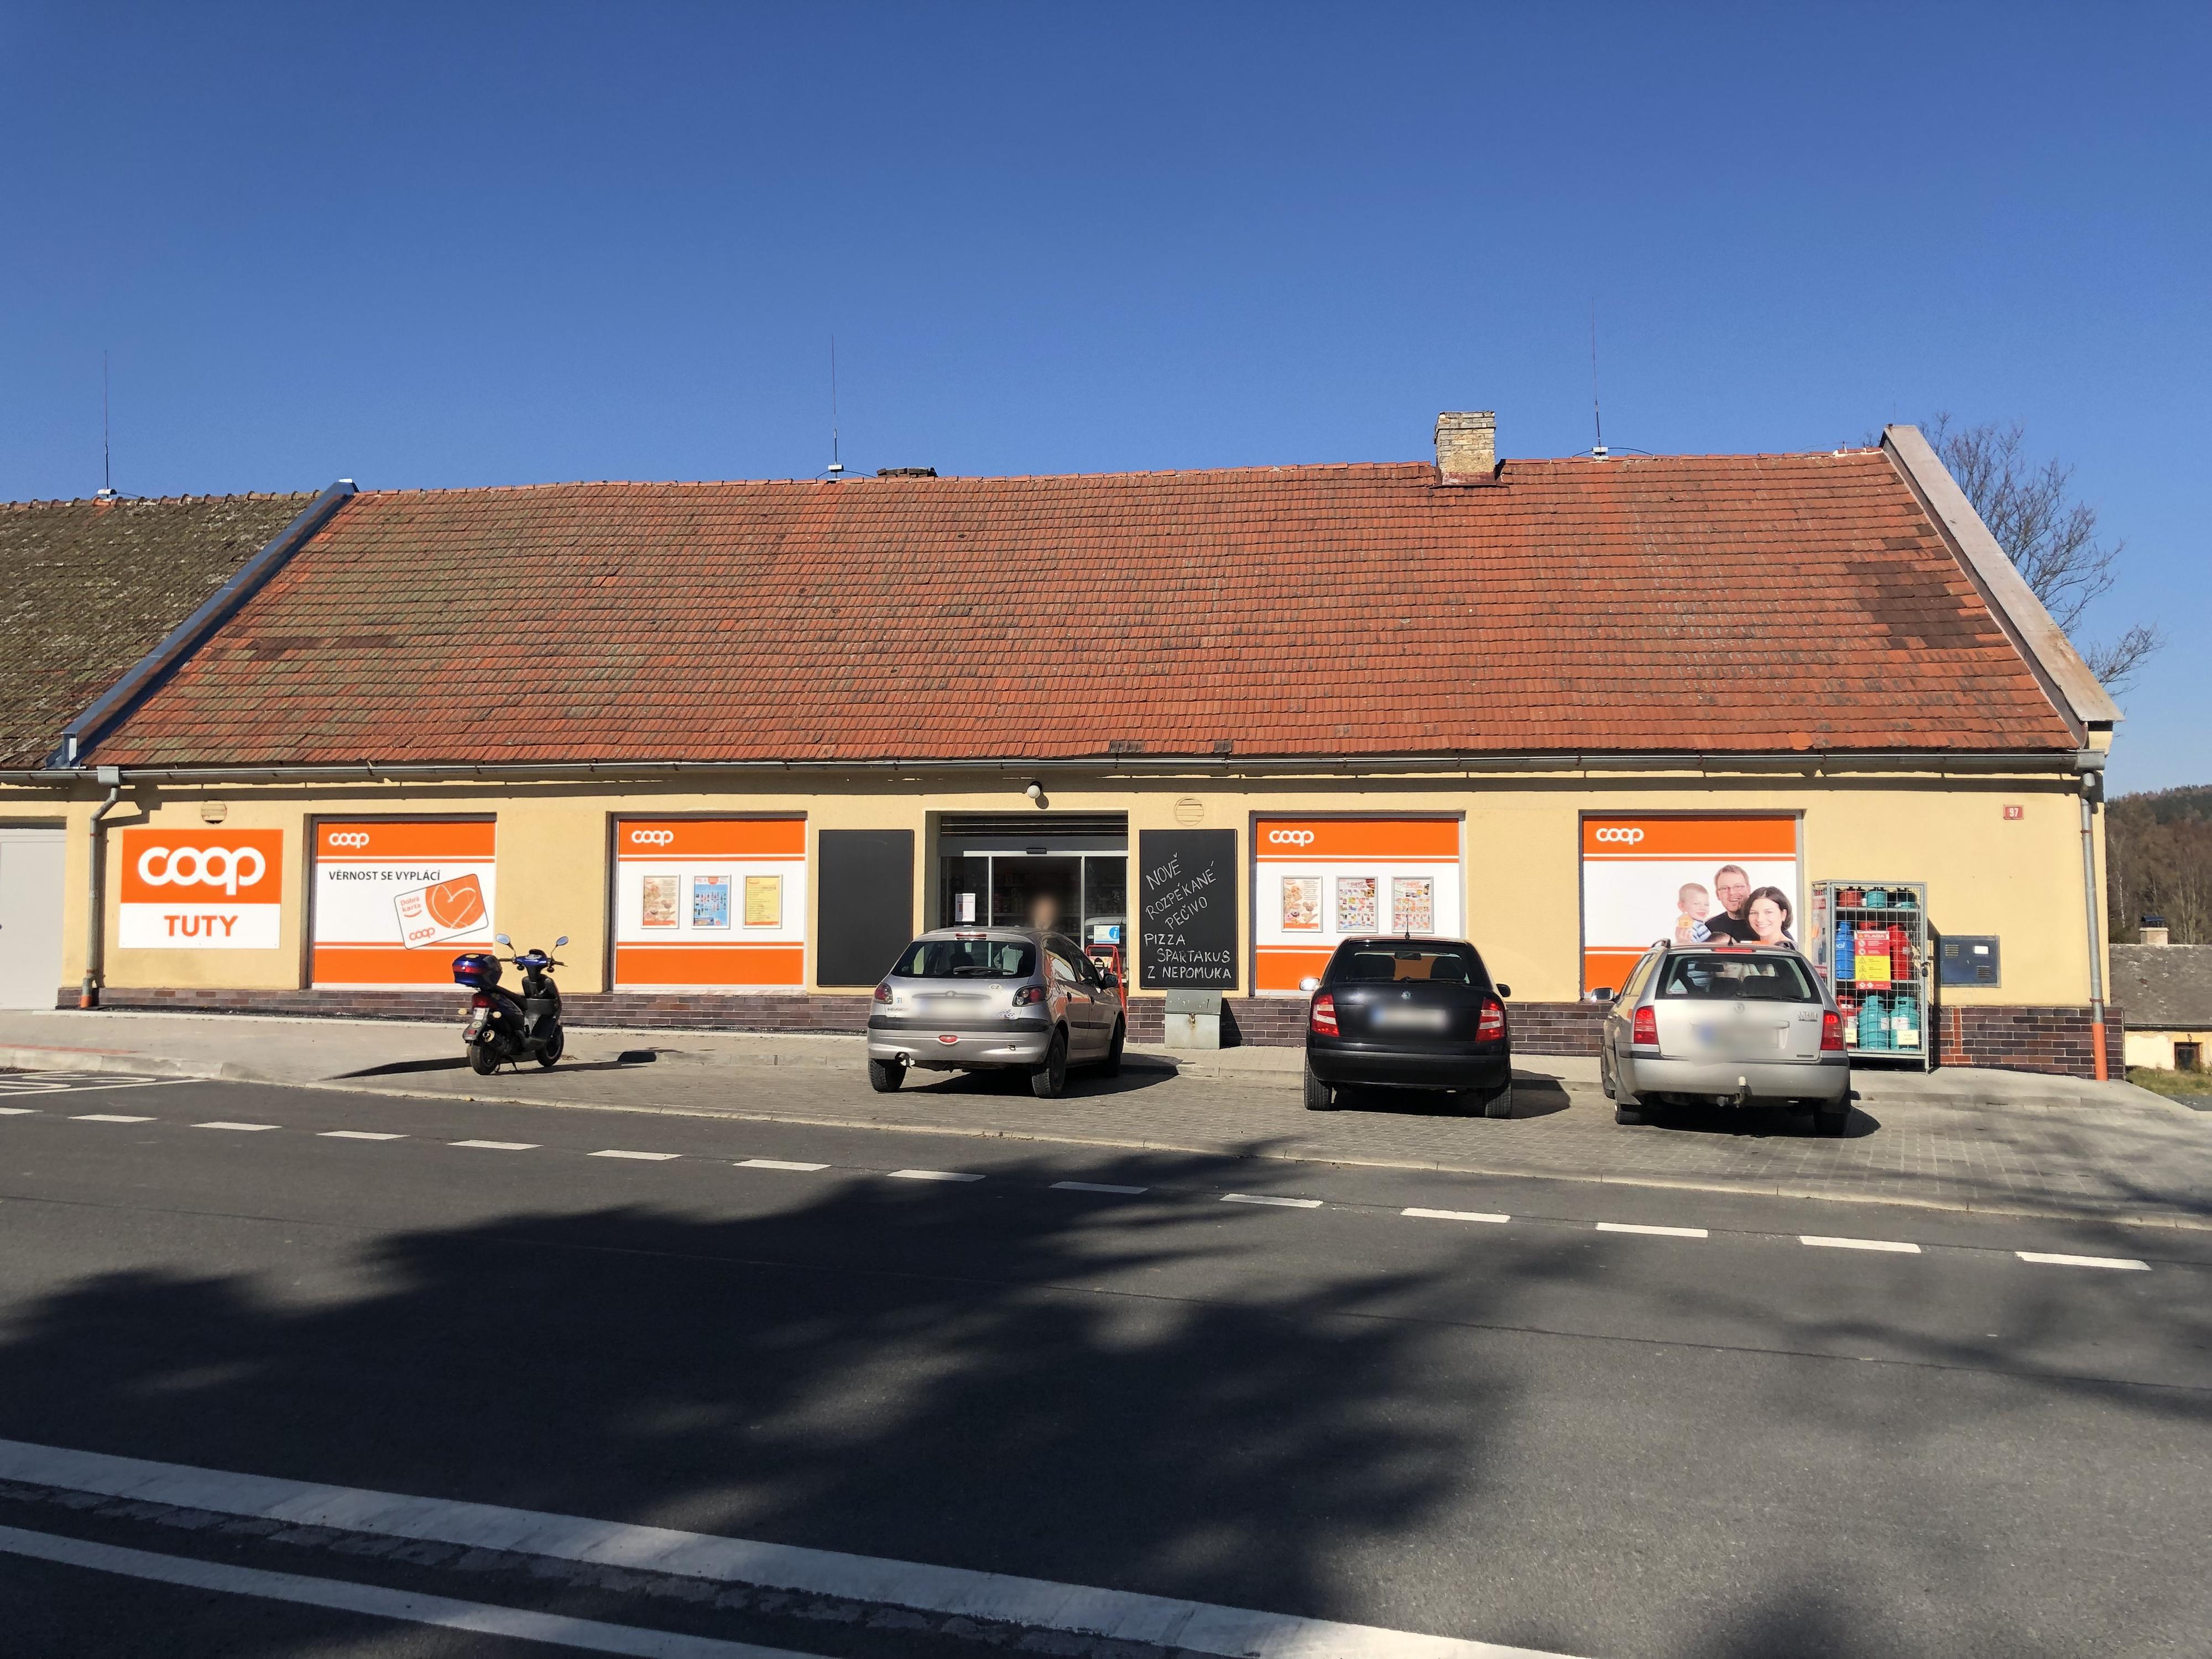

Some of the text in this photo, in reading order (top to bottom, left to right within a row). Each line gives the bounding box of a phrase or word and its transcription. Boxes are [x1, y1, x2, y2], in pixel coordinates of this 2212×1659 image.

[2009, 807, 2019, 817] 97
[328, 832, 370, 848] coop
[631, 830, 674, 847] coop
[1269, 830, 1315, 847] coop
[1595, 828, 1645, 845] coop
[138, 846, 266, 895] coop
[328, 869, 441, 881] VĚRNOST SE VYPLÁCÍ
[402, 903, 421, 912] karta
[1164, 896, 1208, 930] PEČIVO
[164, 915, 238, 936] TUTY
[409, 927, 435, 941] coop
[1144, 933, 1186, 946] PIZZA
[1156, 947, 1230, 963] SPARTAKUS
[1147, 966, 1232, 979] Z NEPOMUKA
